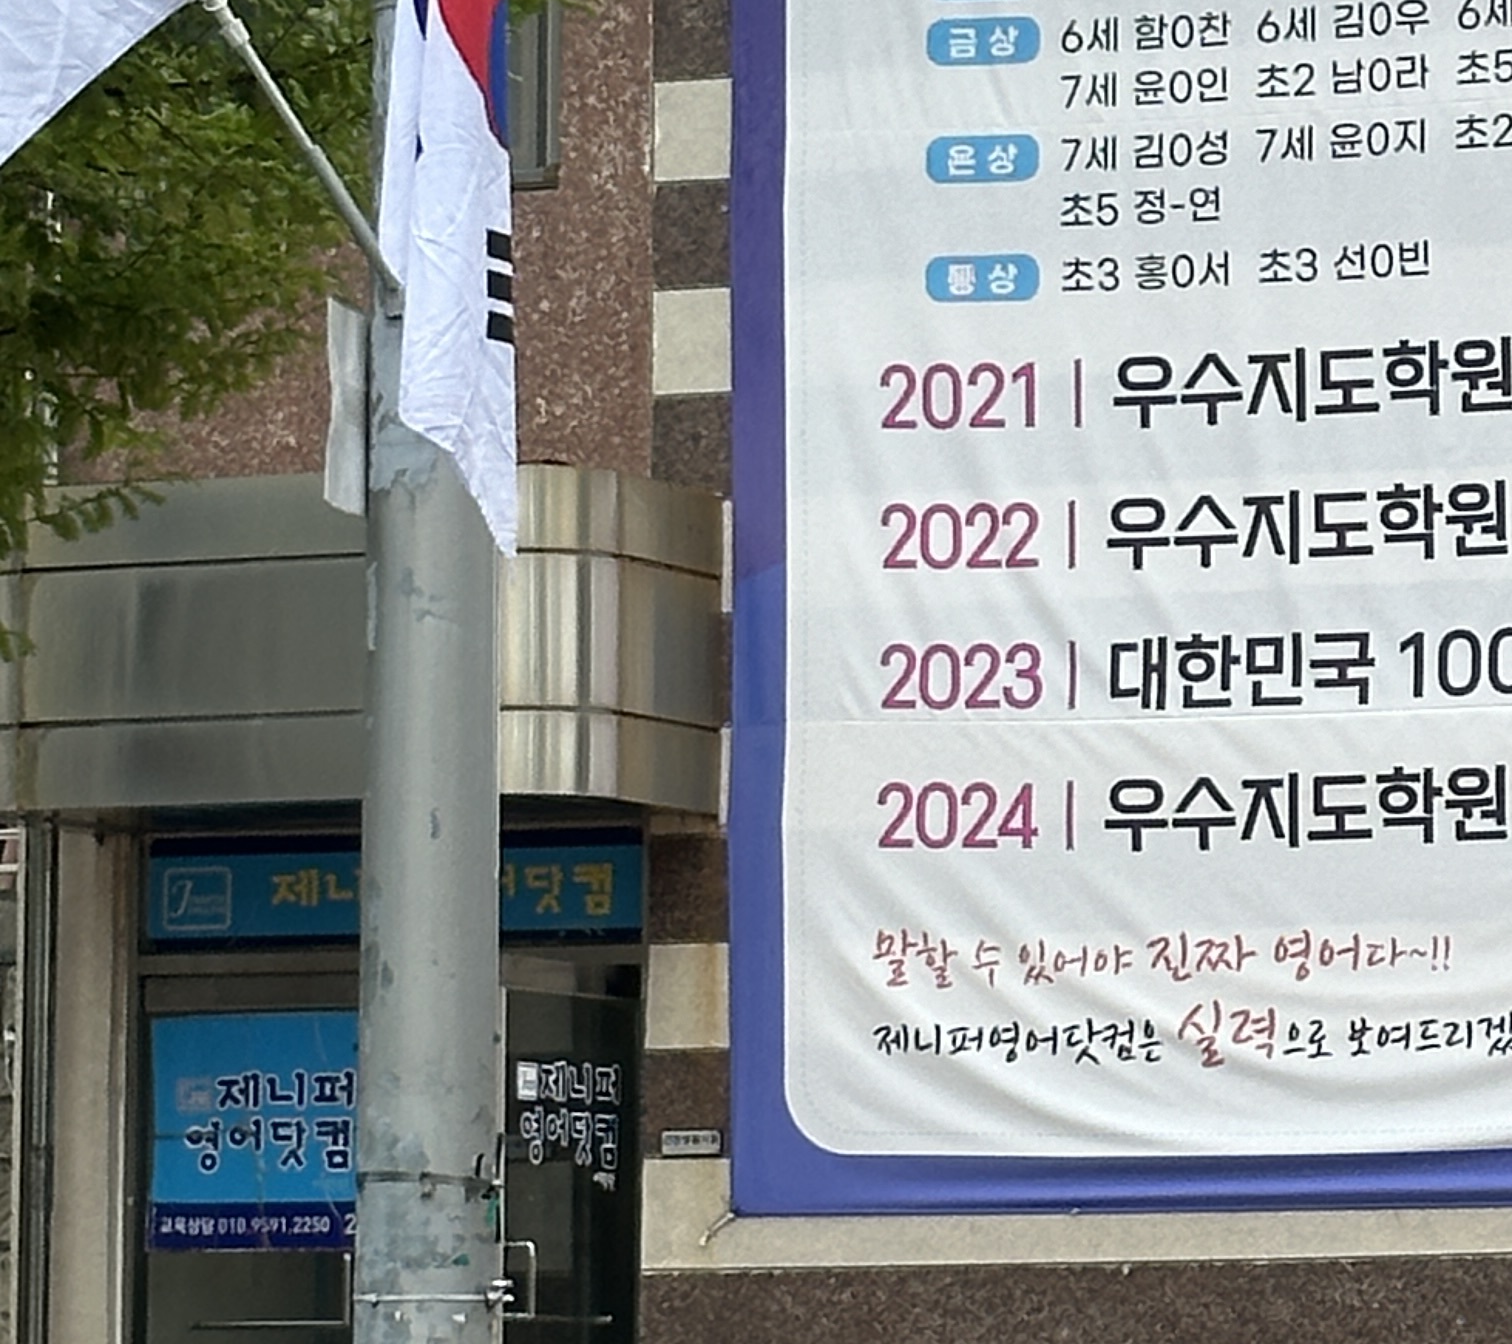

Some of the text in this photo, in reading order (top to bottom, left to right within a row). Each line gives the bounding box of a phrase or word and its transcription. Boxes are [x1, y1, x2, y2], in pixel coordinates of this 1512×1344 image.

[946, 24, 1020, 60] 금상
[1060, 16, 1120, 55] 6세
[1256, 5, 1318, 44] 6세
[1059, 71, 1119, 110] 7세
[1254, 62, 1317, 100] 초2
[946, 143, 1019, 177] 은상
[1059, 134, 1119, 173] 7세
[1254, 123, 1316, 164] 7세
[1060, 185, 1222, 228] 초5 정-연
[1060, 256, 1121, 293] 초3
[1257, 248, 1319, 286] 초3
[879, 361, 1037, 431] 2021
[879, 478, 1510, 571] 2022 우수지도학원
[878, 641, 1044, 711] 2023
[1108, 631, 1377, 712] 대한민국
[876, 763, 1509, 853] 2024 우수지도학원
[872, 928, 959, 990] 말할
[970, 938, 1001, 989] 수
[1017, 938, 1133, 986] 있어야
[1146, 929, 1258, 983] 진짜
[871, 1017, 1164, 1066] 제니퍼영어닷컴은
[216, 1068, 357, 1111] 제니퍼
[539, 1060, 622, 1104] 제니퍼
[184, 1116, 353, 1174] 영어닷컴
[519, 1105, 620, 1170] 영어닷컴
